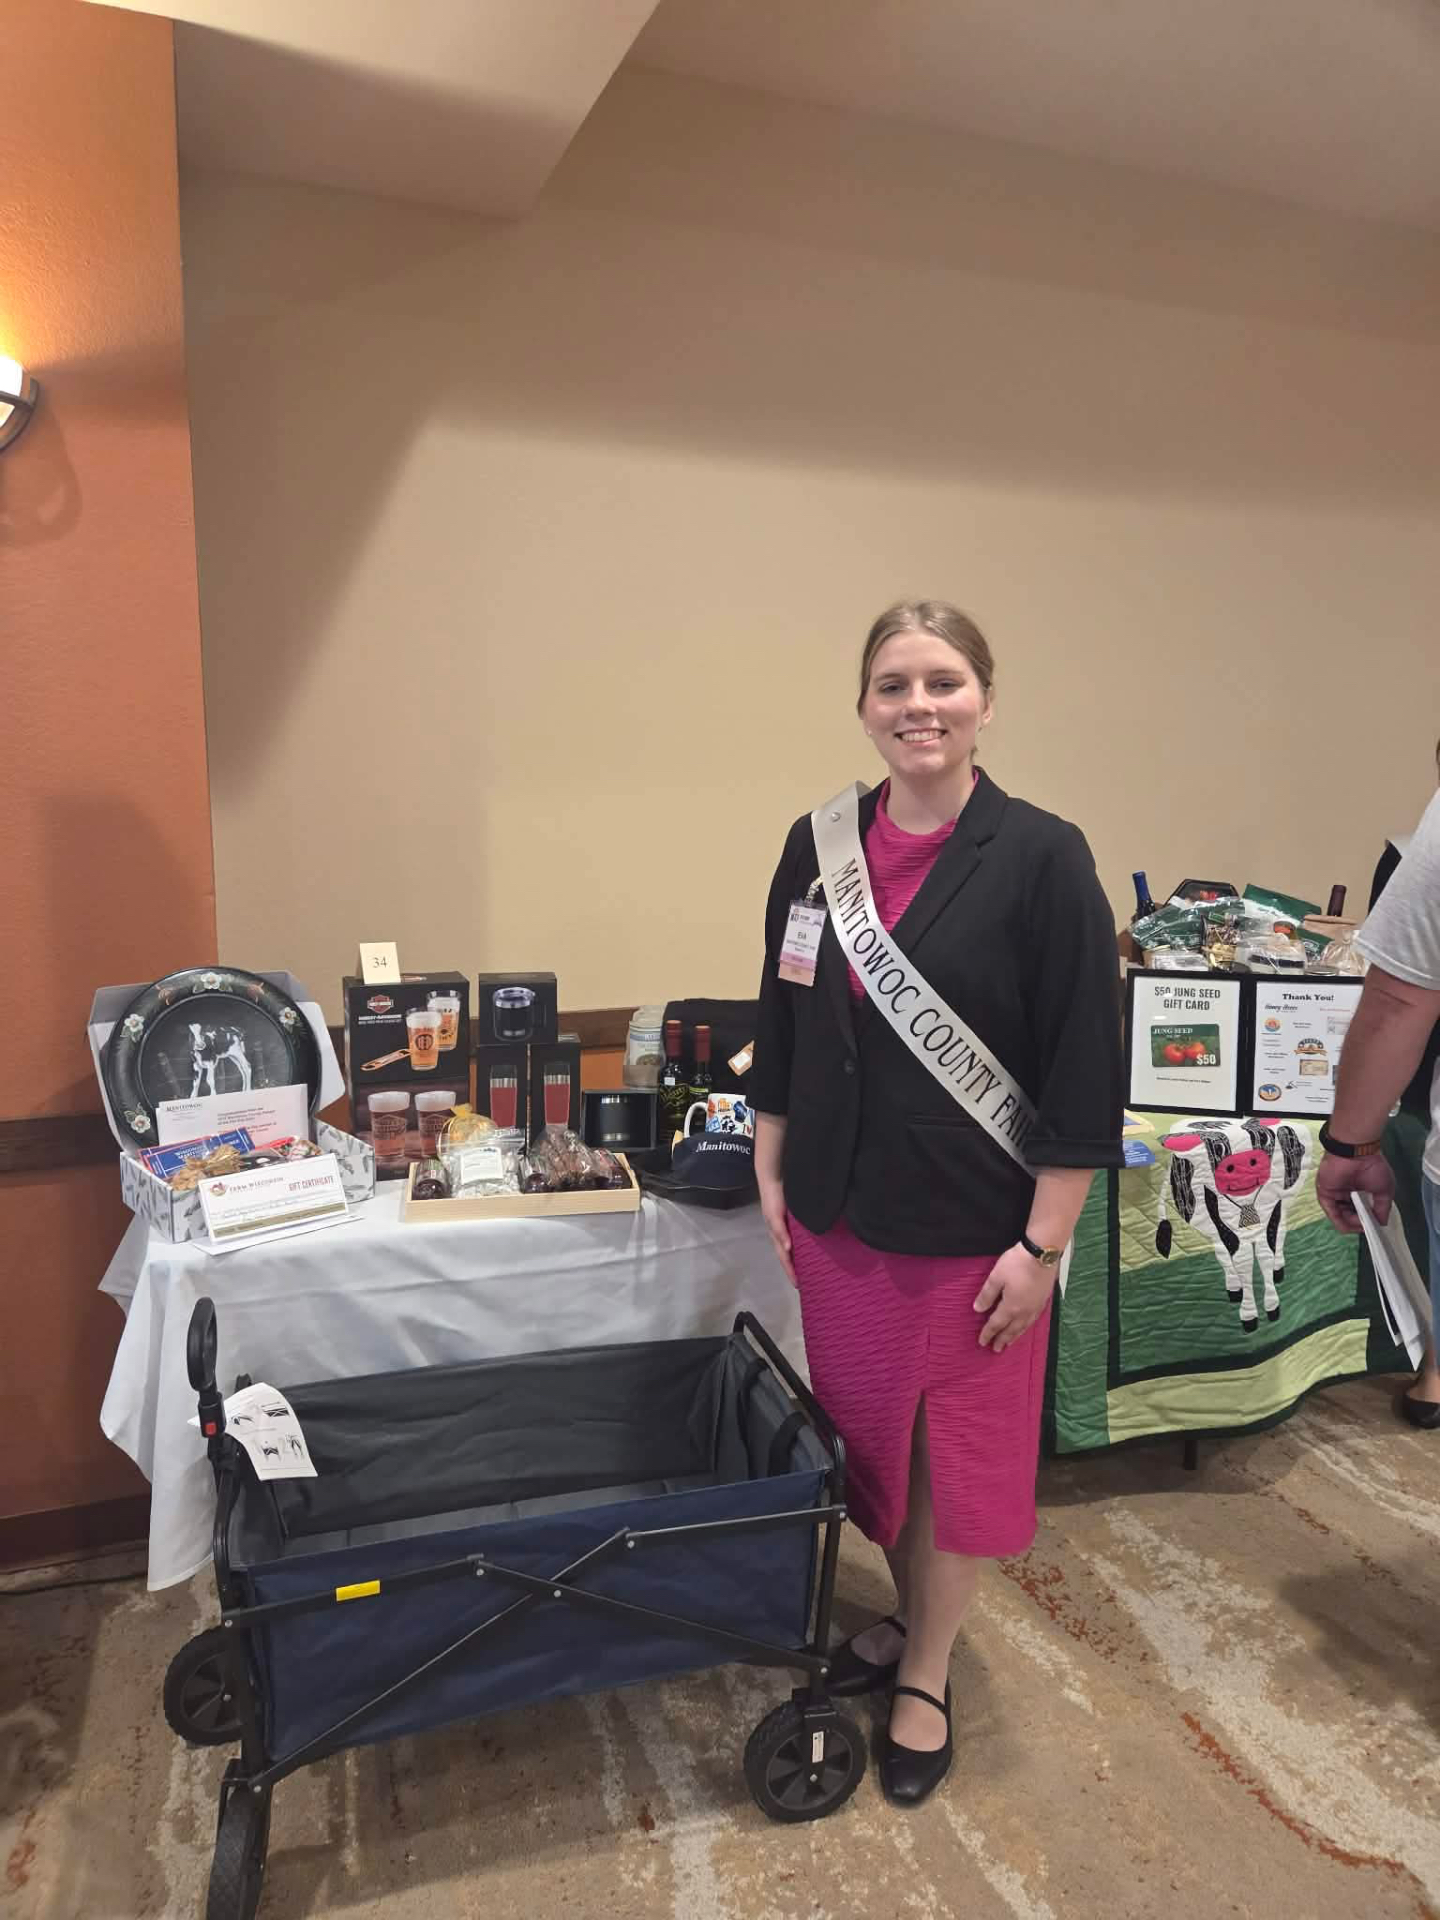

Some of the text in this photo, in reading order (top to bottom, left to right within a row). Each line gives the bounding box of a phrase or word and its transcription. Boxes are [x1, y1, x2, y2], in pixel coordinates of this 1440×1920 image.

[373, 956, 387, 969] 34
[832, 858, 921, 1014] MANITOWOC
[909, 1008, 1003, 1105] COUNTY
[1154, 986, 1221, 999] $50 JUNG SEED
[1282, 993, 1335, 1002] Thank You!
[1163, 999, 1210, 1011] GIFT CARD
[1152, 1027, 1173, 1035] JUNG
[1196, 1053, 1217, 1066] $50
